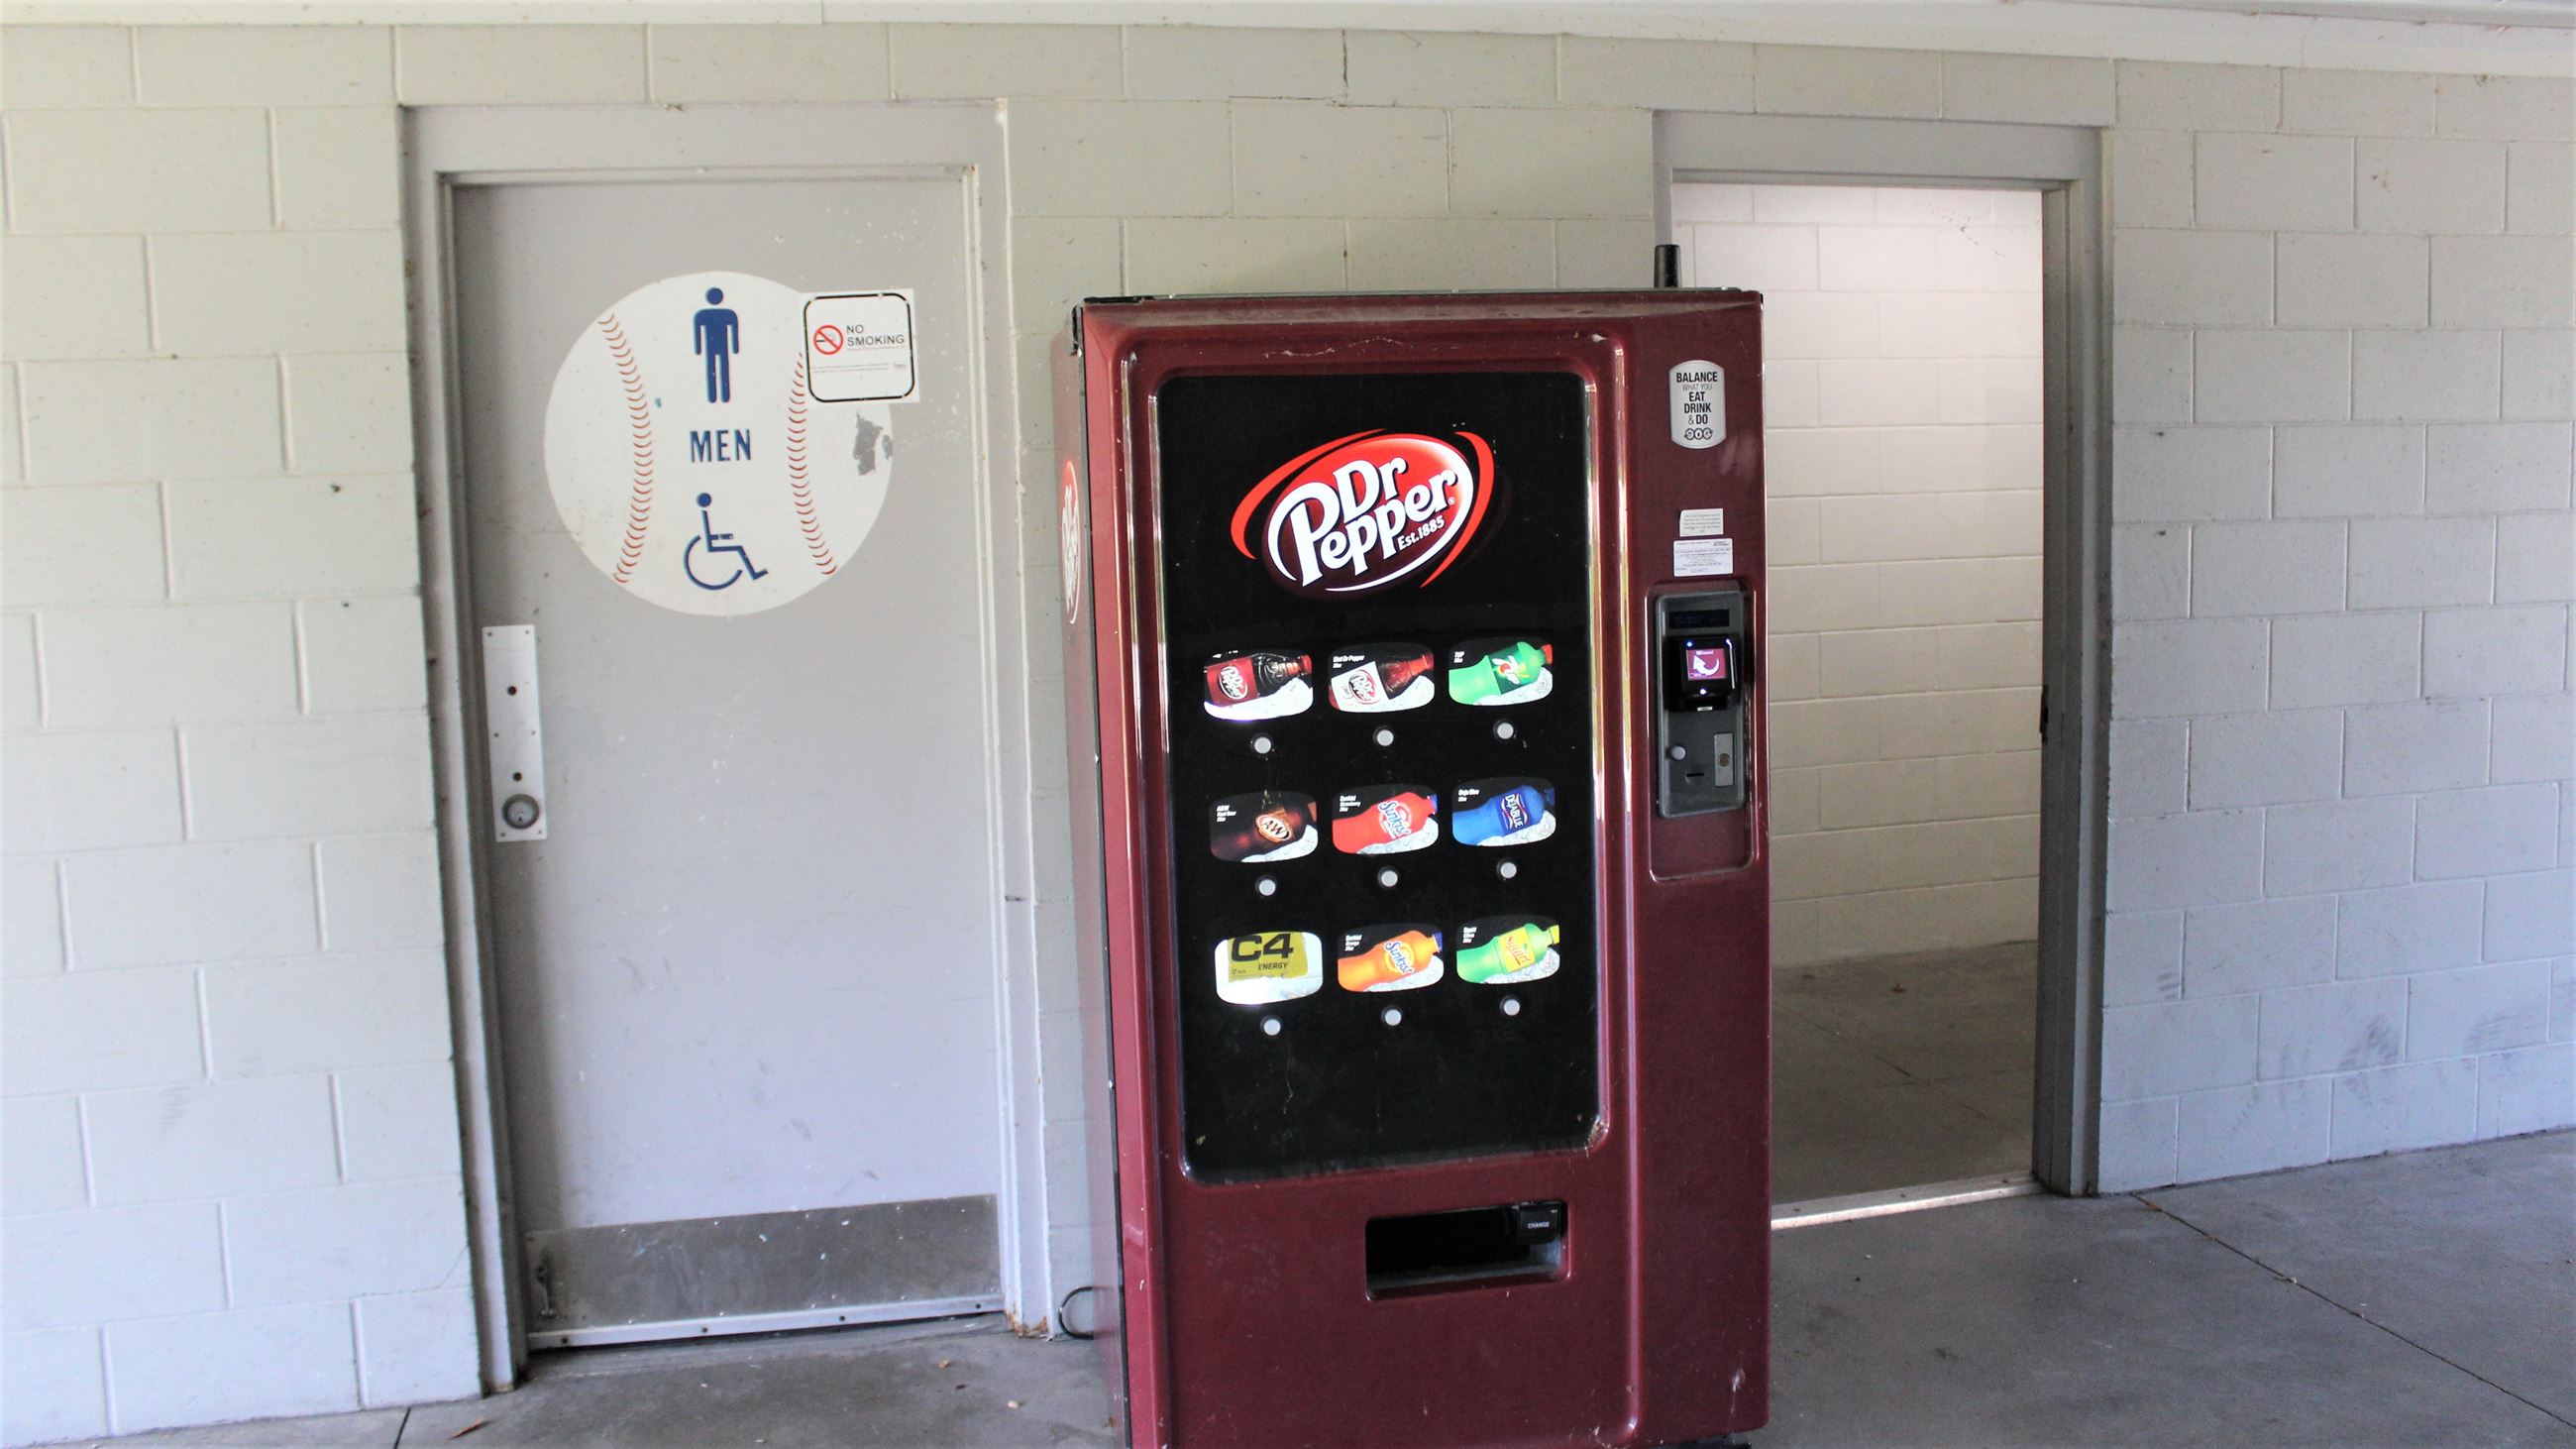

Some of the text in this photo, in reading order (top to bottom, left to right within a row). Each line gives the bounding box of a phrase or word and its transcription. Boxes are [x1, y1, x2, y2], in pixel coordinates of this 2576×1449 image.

[846, 324, 864, 334] NO
[847, 334, 905, 347] SMOKING
[1676, 372, 1718, 383] BALANCE
[1688, 391, 1705, 402] EAT
[1684, 403, 1712, 413] DRINK
[1688, 414, 1708, 425] & DO
[690, 428, 751, 463] MEN
[1333, 458, 1407, 522] Dr
[1268, 469, 1456, 587] Pepper
[1232, 933, 1294, 961] C4
